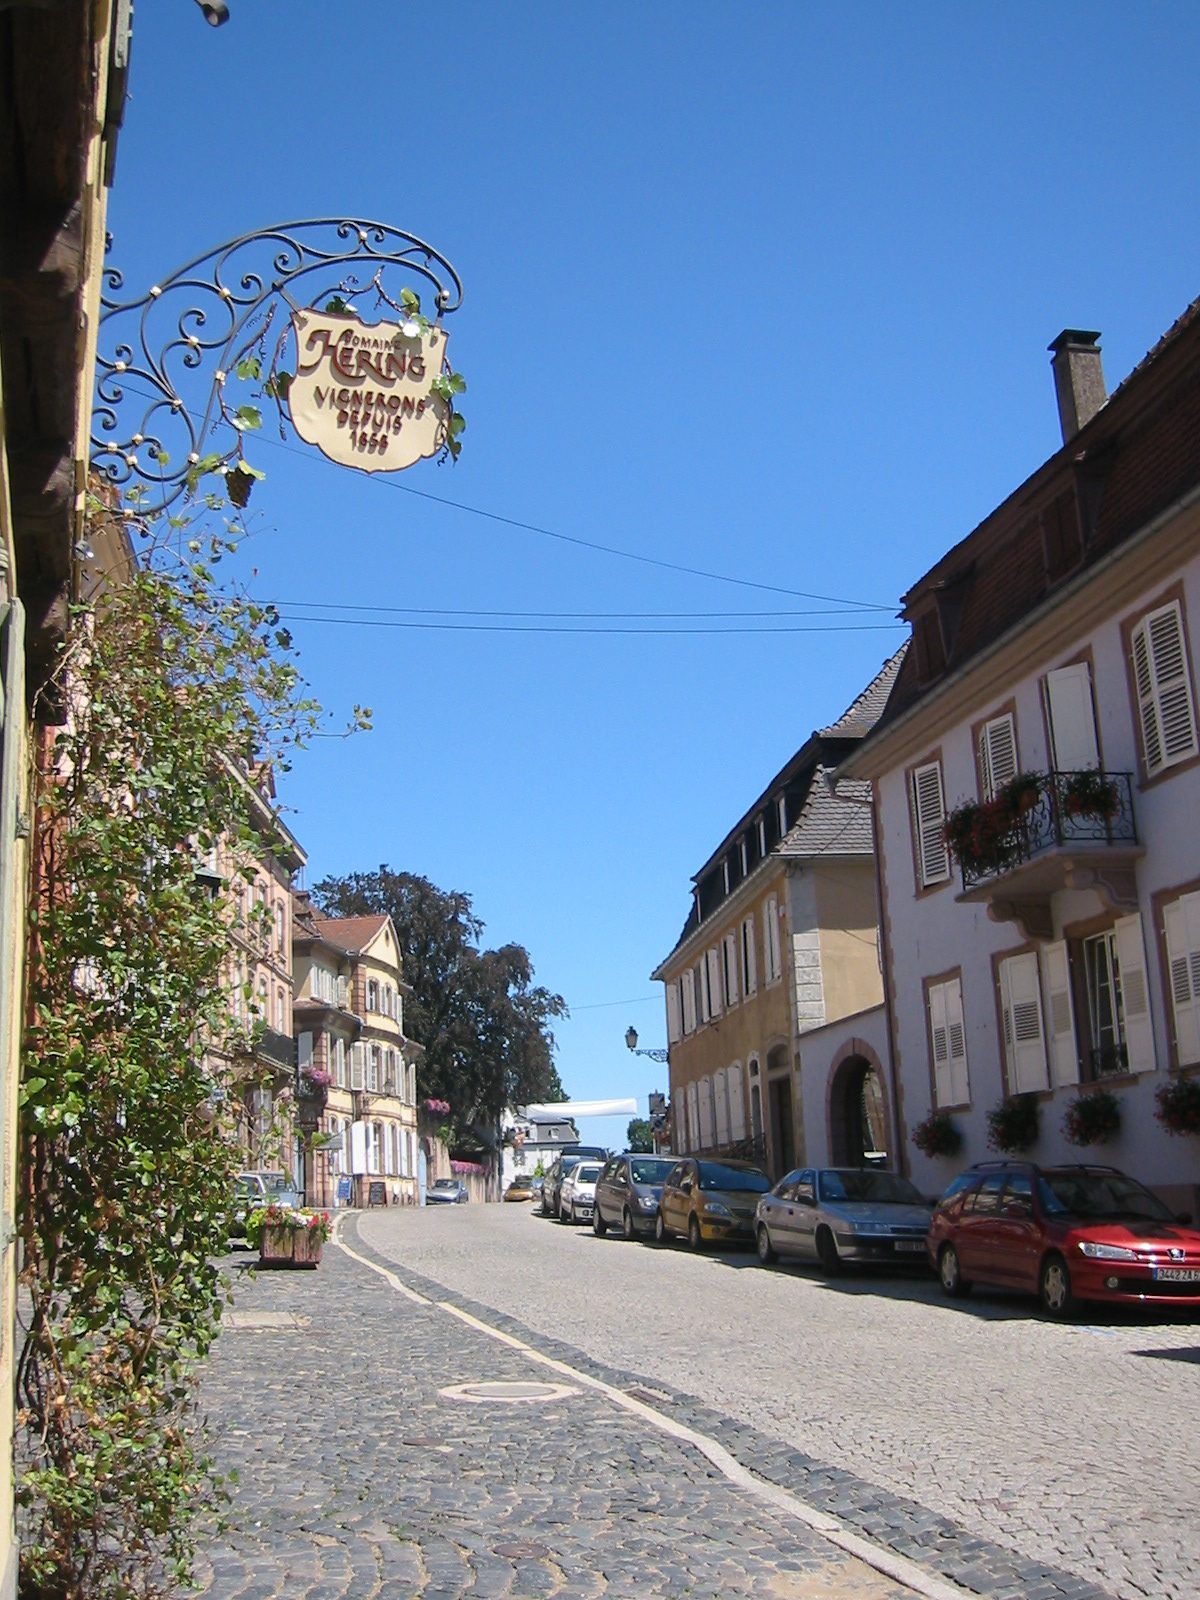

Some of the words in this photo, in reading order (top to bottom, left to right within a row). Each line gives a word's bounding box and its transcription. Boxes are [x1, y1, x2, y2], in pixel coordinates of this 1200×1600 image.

[344, 328, 402, 351] DOMAINE
[301, 329, 426, 381] HERING
[314, 386, 426, 414] VIGNERONS
[338, 409, 402, 431] DEPUIS
